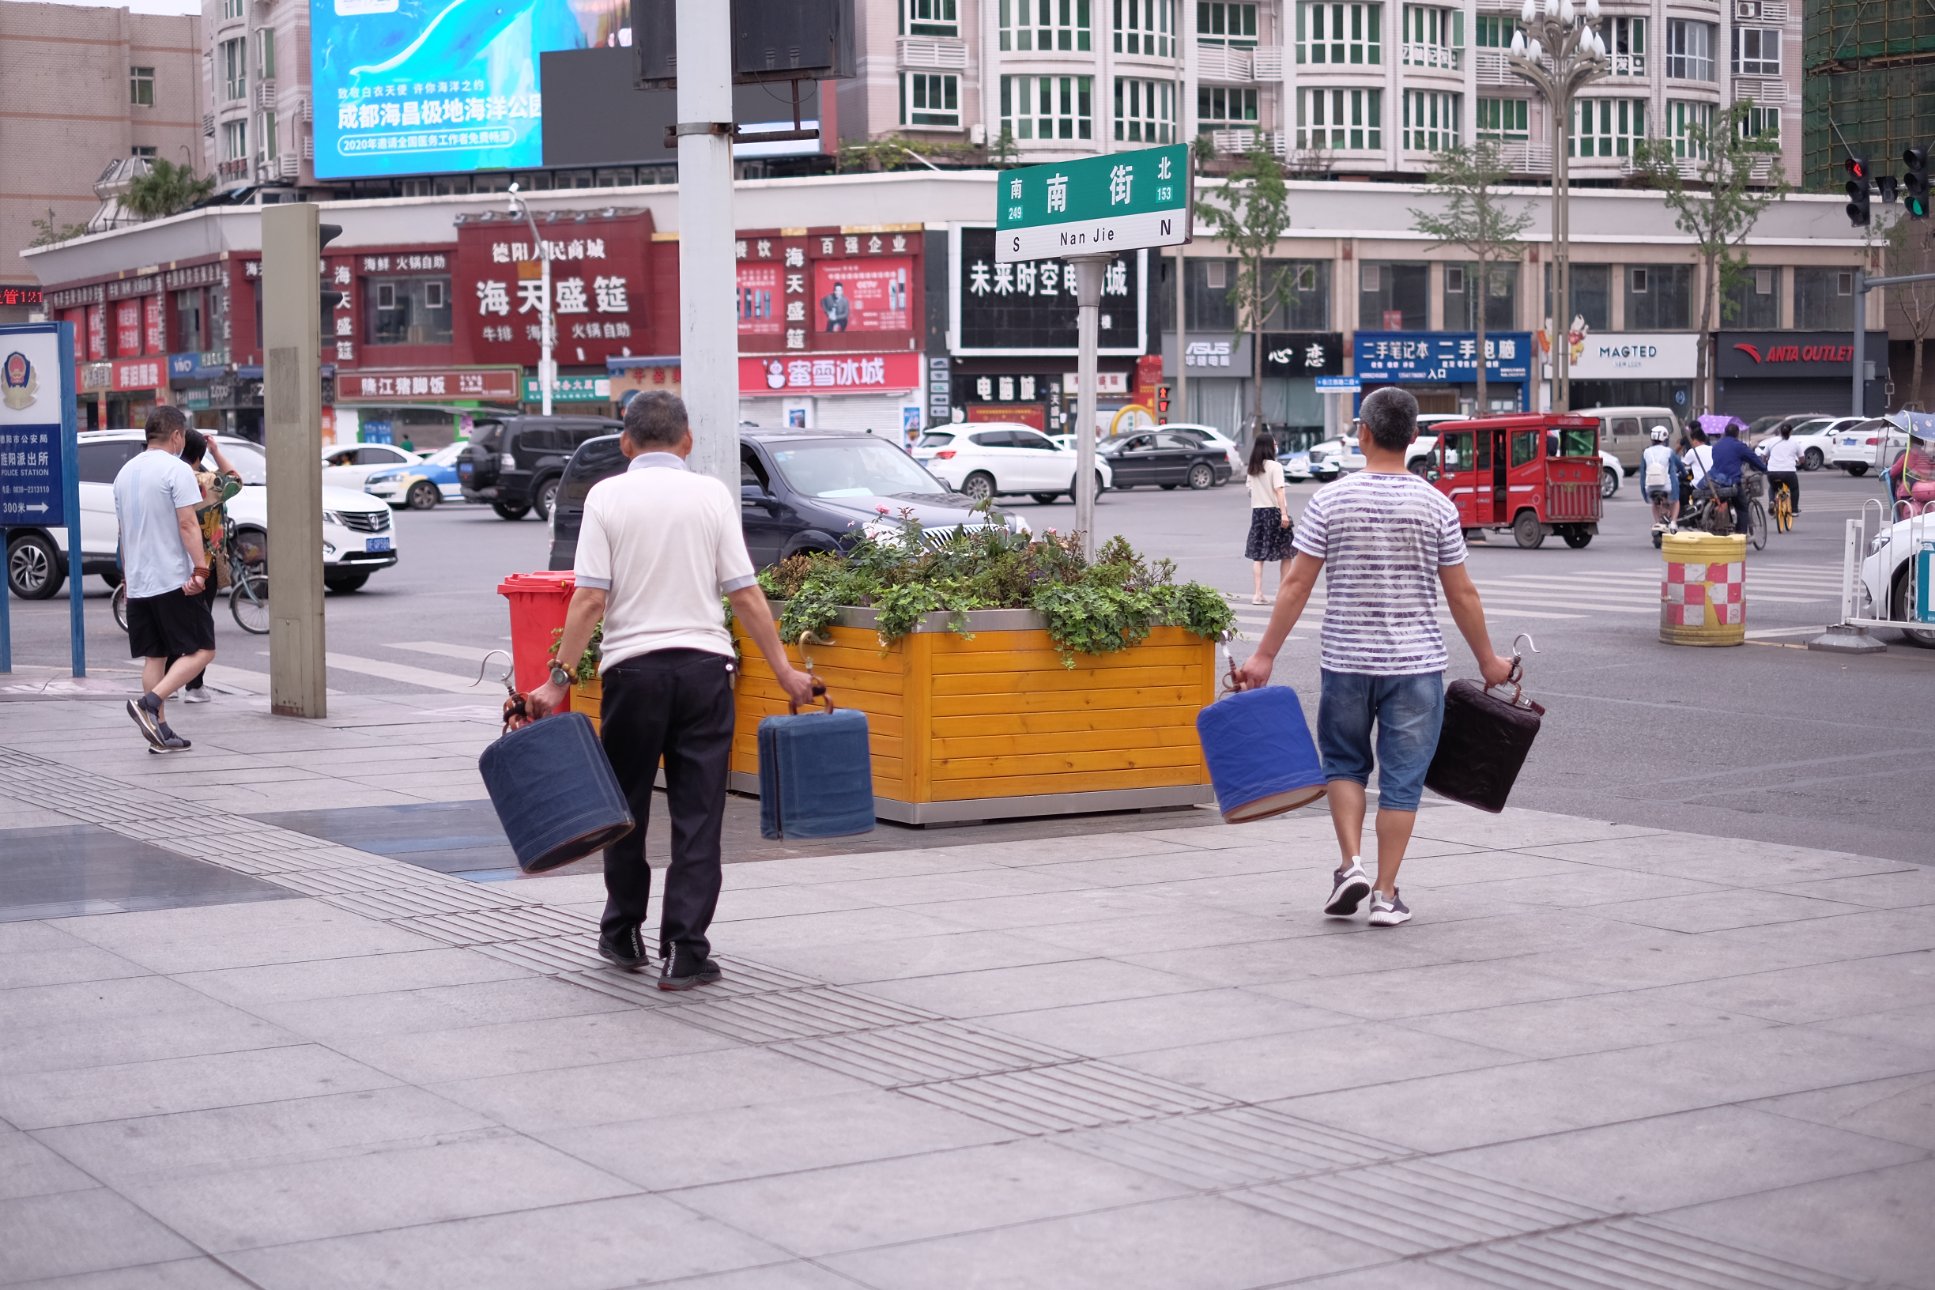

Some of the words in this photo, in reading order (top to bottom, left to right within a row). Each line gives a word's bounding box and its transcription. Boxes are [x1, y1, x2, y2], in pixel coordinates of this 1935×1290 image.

[338, 84, 407, 99] 致敬白衣天使
[413, 80, 484, 95] 许你海洋之约
[338, 93, 541, 129] 成都海昌极地海洋公园
[1010, 178, 1023, 199] 南
[1046, 164, 1134, 214] 南街
[1157, 156, 1172, 180] 北
[1008, 206, 1023, 220] 249
[1157, 187, 1172, 201] 153
[820, 236, 906, 255] 百强企业
[1012, 236, 1021, 252] S
[1060, 231, 1086, 246] Nan
[1093, 227, 1114, 243] Jie
[1160, 218, 1172, 236] N
[364, 257, 390, 272] 海鲜
[396, 254, 446, 271] 火锅自助
[970, 259, 1128, 297] 未来时空电城
[476, 276, 629, 316] 海天盛筵
[785, 247, 806, 349] 海天盛筵
[335, 266, 353, 360] 海天盛筵
[482, 325, 513, 342] 牛排
[572, 321, 632, 339] 火锅自助
[1186, 342, 1230, 354] ASUS
[1268, 343, 1326, 367] 心恋
[1362, 341, 1430, 360] 二手笔记本
[1437, 339, 1515, 359] 二手电脑
[1600, 345, 1657, 358] MAGTED
[1767, 346, 1798, 362] ANTA
[1802, 345, 1855, 362] OUTLET
[1185, 355, 1230, 366] 华硕电脑
[787, 357, 885, 387] 蜜雪冰城
[1428, 368, 1446, 379] 入口
[20, 468, 49, 476] STATION
[3, 503, 26, 514] 300米
